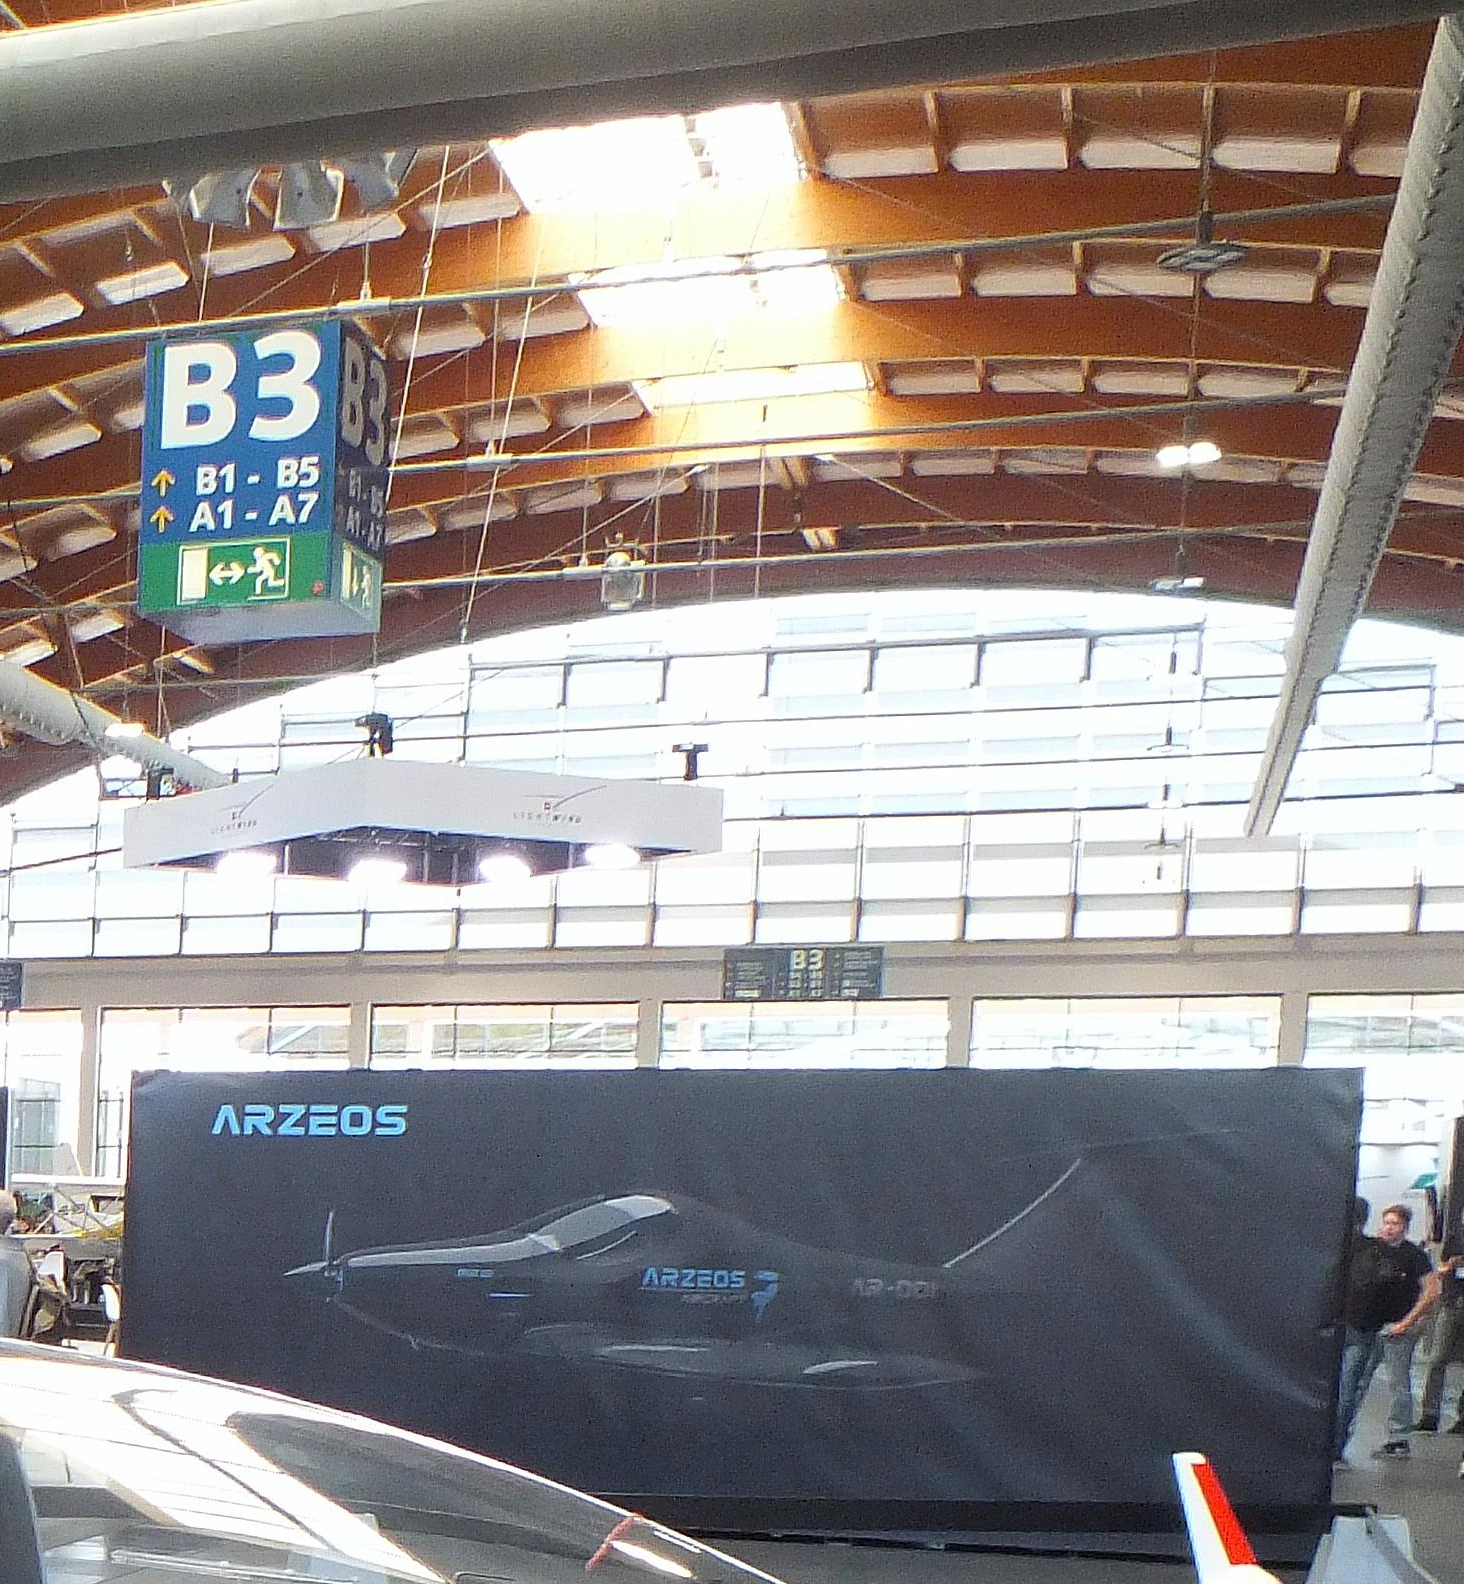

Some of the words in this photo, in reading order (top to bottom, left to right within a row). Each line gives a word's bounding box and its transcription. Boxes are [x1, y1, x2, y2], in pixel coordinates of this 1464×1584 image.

[161, 330, 322, 449] B3
[341, 337, 388, 466] B3
[195, 462, 236, 496] B1
[276, 456, 321, 492] B5
[189, 498, 233, 533] A1
[269, 495, 317, 526] A7
[790, 950, 823, 970] B3
[211, 1103, 408, 1137] ARZEOS
[642, 1267, 746, 1288] ARZEOS
